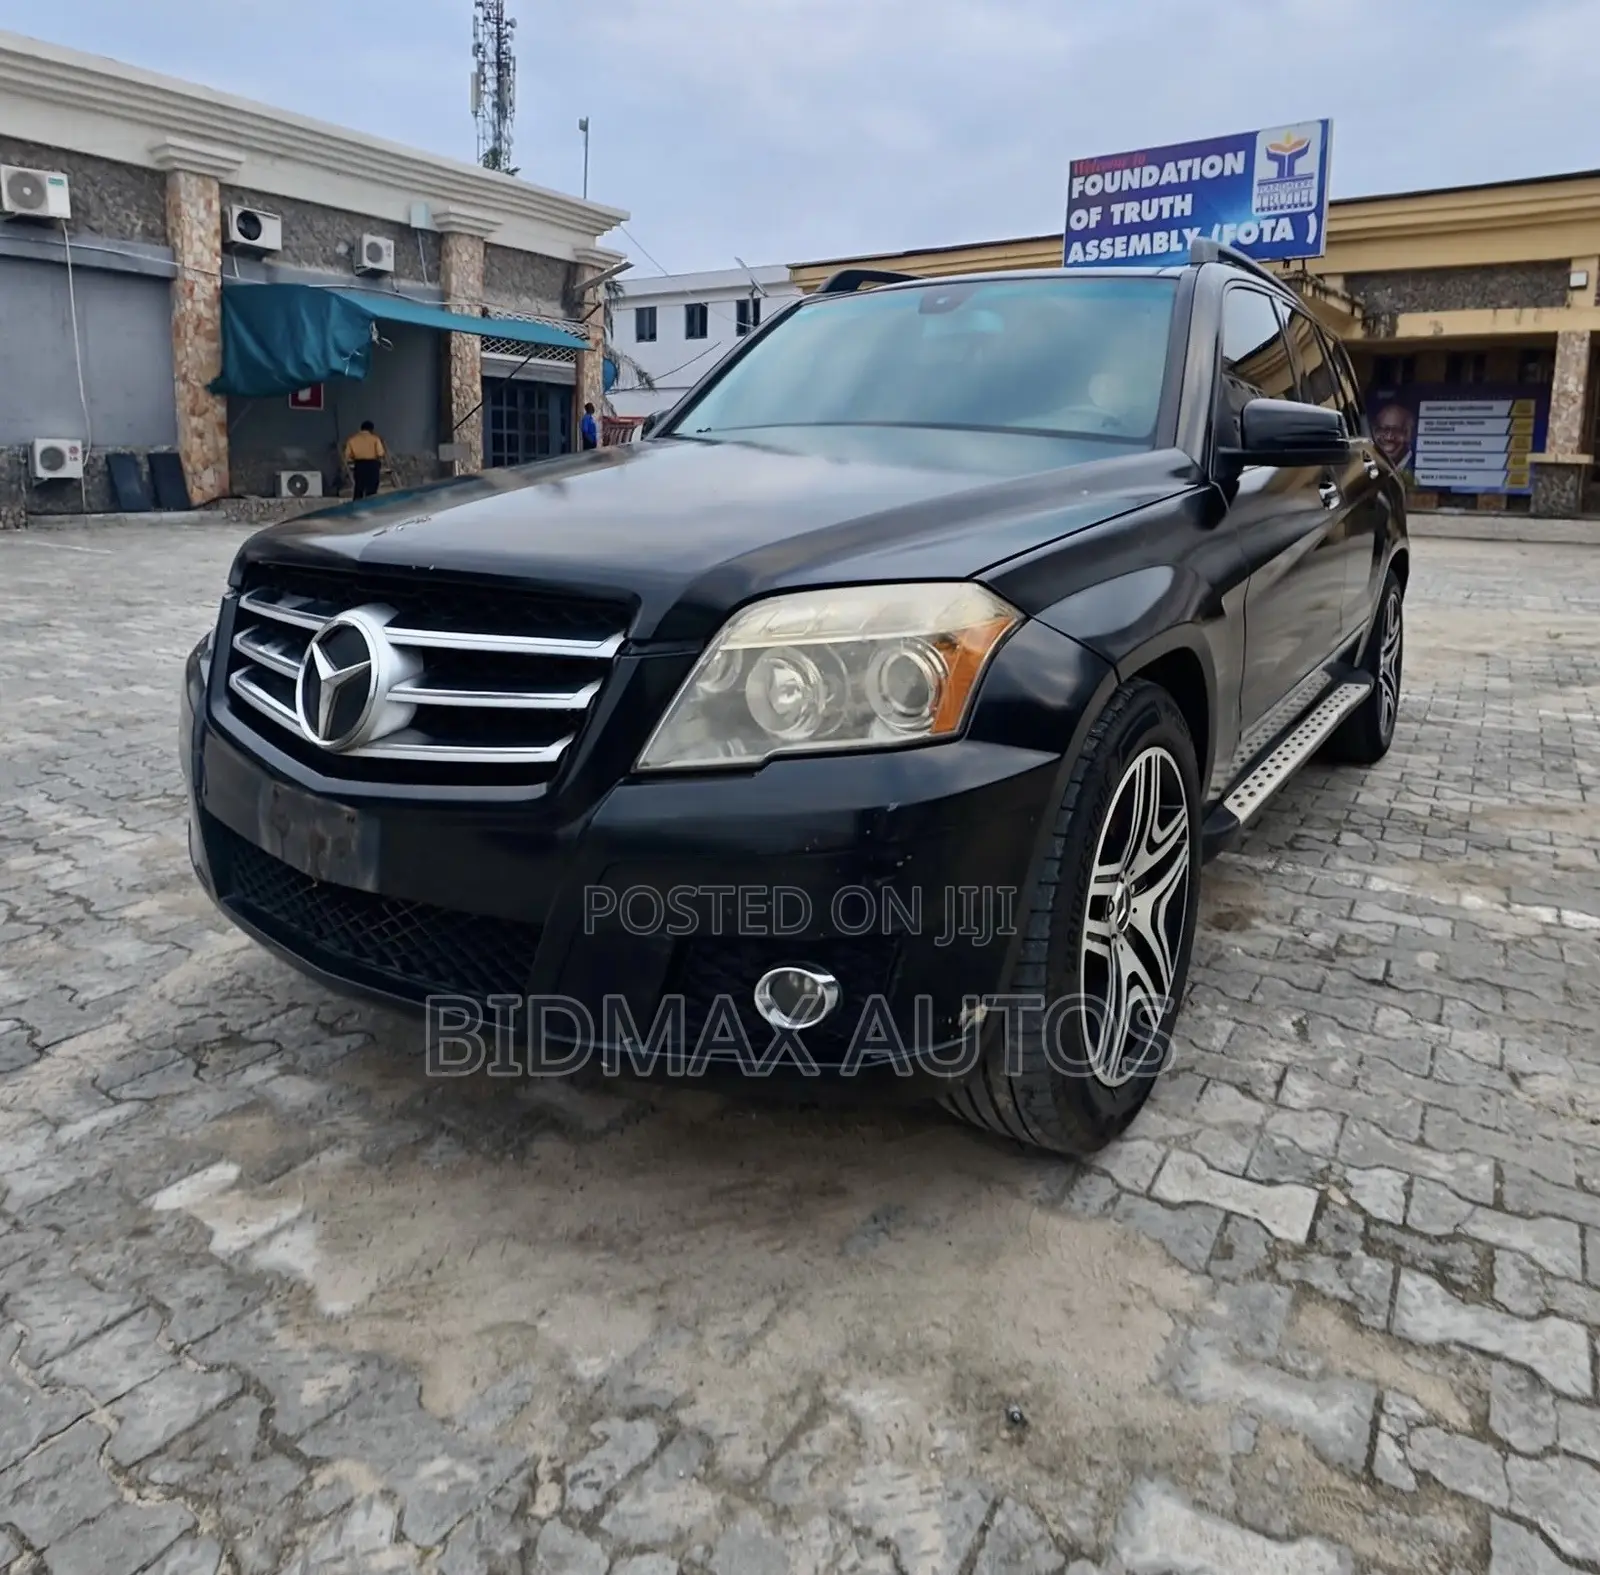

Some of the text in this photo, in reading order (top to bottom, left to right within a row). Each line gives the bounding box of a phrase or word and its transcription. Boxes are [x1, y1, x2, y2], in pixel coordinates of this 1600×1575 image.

[1072, 151, 1245, 199] FOUNDATION
[1069, 193, 1193, 232] OF TRUTH
[1066, 227, 1202, 264] ASSEMBLY
[1211, 217, 1295, 247] (FOTA
